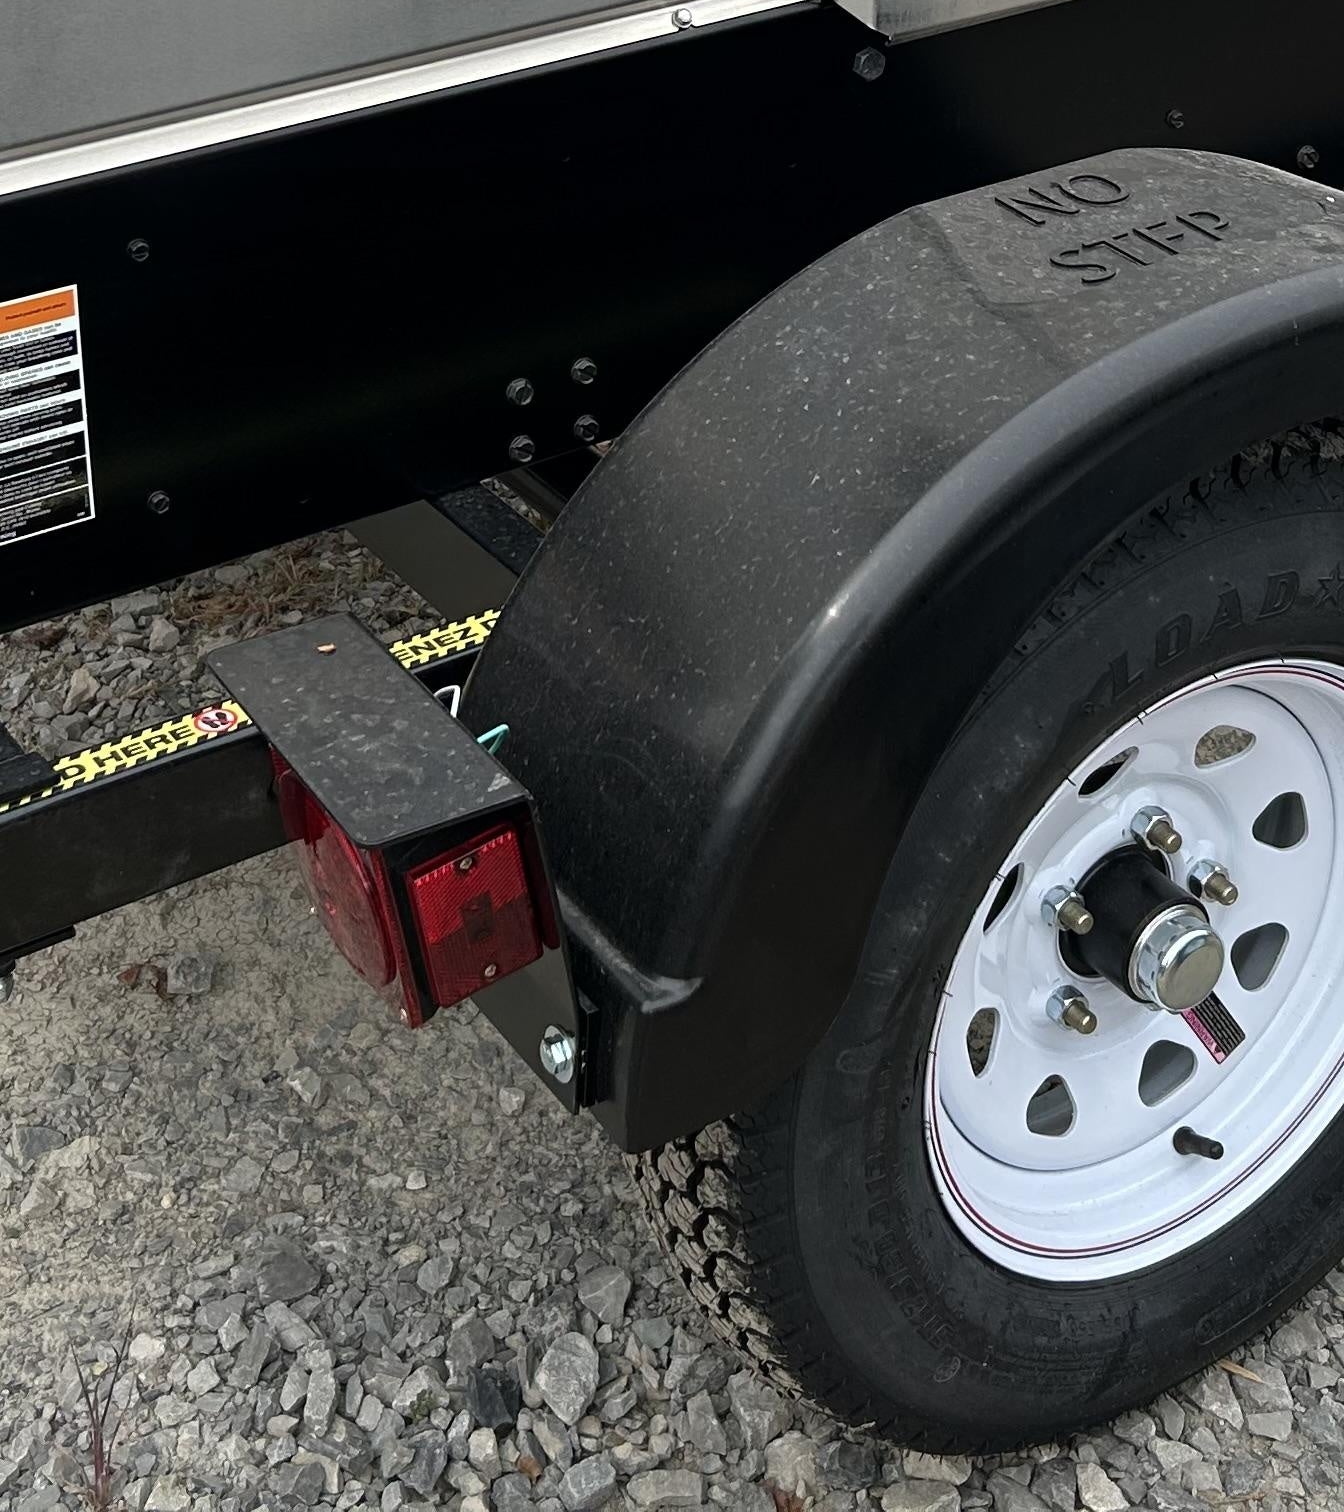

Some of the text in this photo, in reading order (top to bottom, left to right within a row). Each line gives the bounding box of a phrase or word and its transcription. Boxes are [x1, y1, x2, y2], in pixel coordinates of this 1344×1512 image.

[995, 175, 1129, 226] NO
[1050, 212, 1229, 284] STEP
[392, 626, 480, 662] ENEZ
[92, 724, 195, 768] HERE
